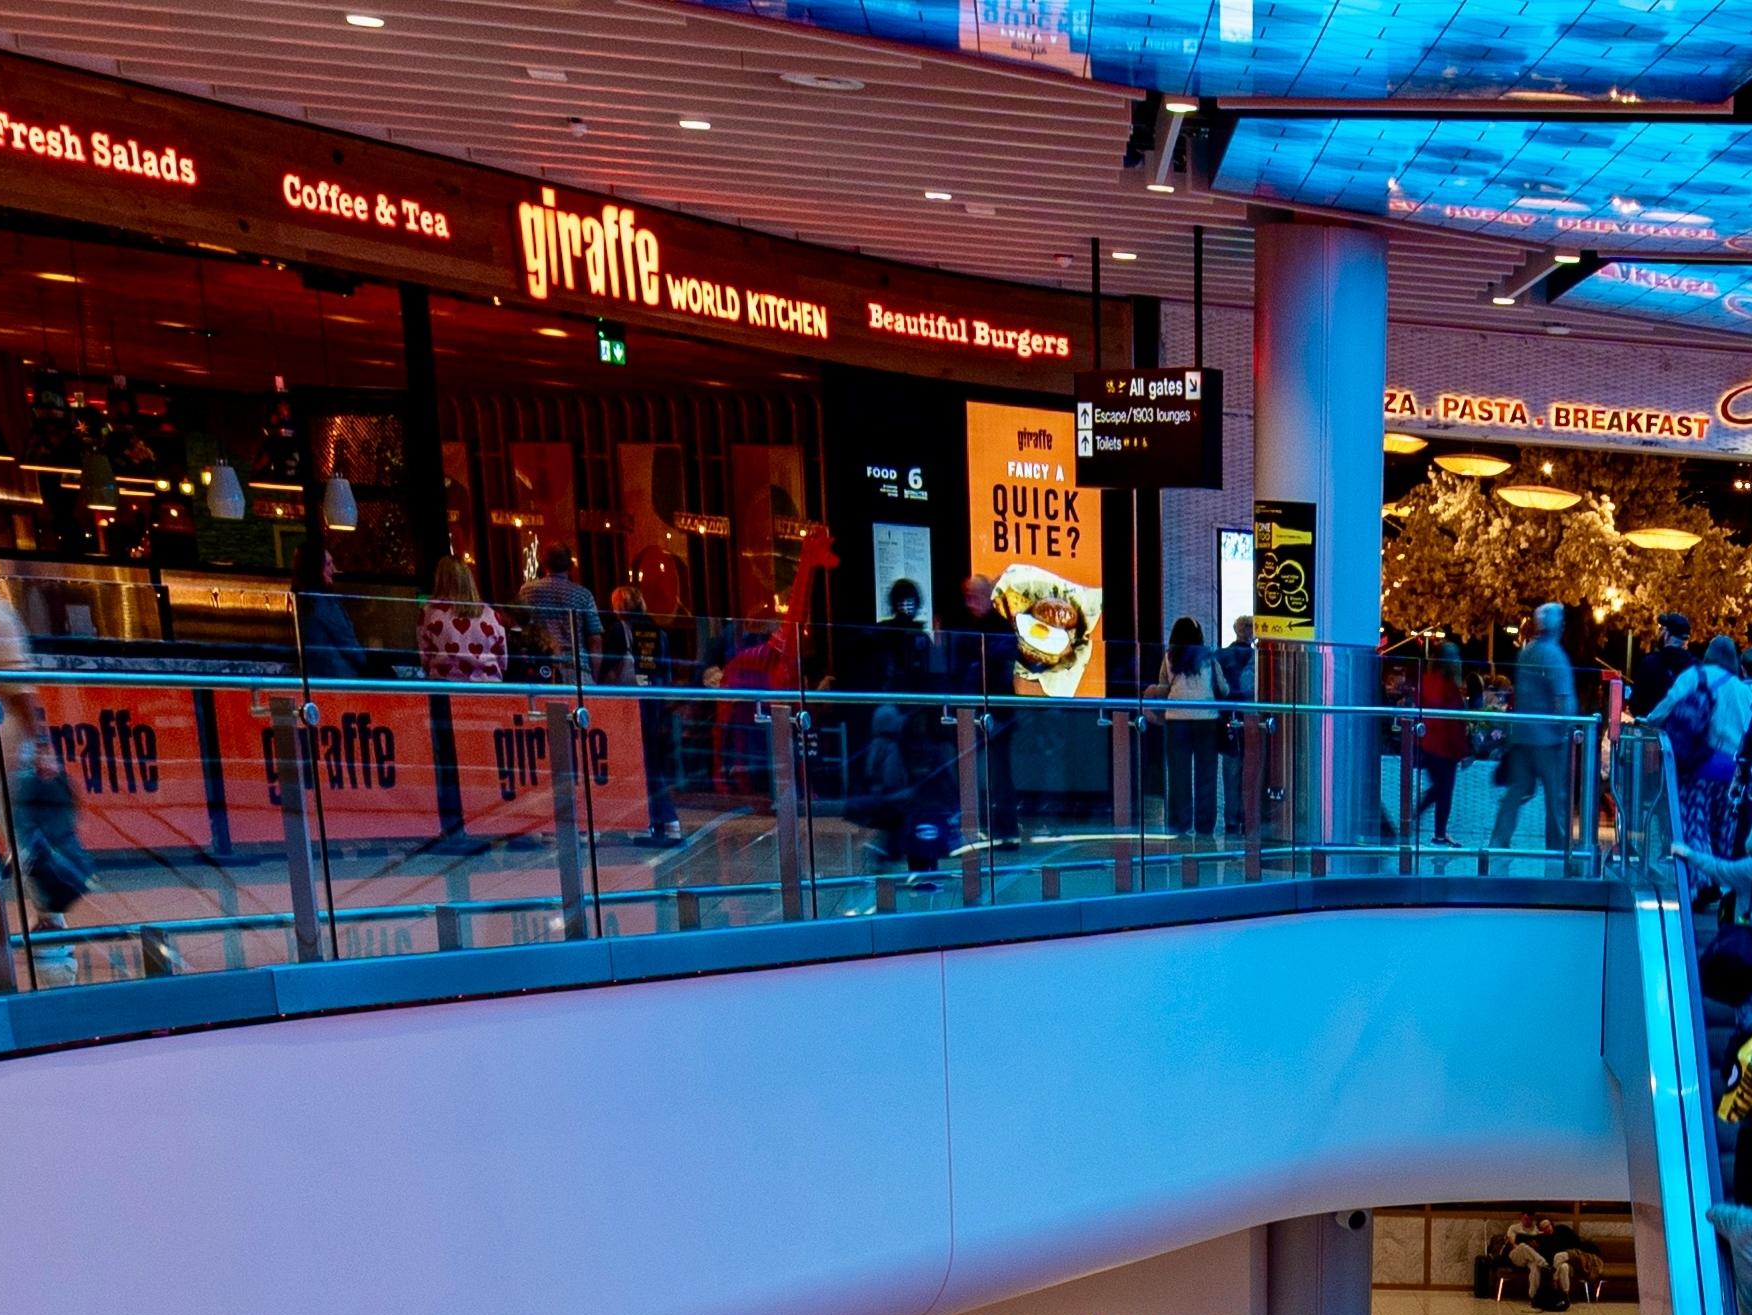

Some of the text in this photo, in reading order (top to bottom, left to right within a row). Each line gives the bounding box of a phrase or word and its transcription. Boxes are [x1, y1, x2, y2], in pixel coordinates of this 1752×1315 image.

[92, 133, 196, 184] Salads
[282, 175, 450, 239] Coffee & Tea
[519, 187, 828, 339] giraffe WORLD KITCHEN
[867, 303, 1069, 358] Beautiful Burgers
[1129, 375, 1183, 398] All gates
[1094, 408, 1191, 424] Escape/1903 lounges
[1443, 396, 1529, 427] PASTA
[1553, 408, 1710, 440] BREAKFAST
[1017, 427, 1054, 451] giraffe
[1095, 435, 1122, 451] Toilets
[866, 466, 897, 480] FOOD
[907, 467, 923, 489] 6
[1008, 461, 1065, 481] FANCY A
[992, 484, 1081, 523] QUICK
[993, 521, 1081, 558] BITE?
[261, 712, 396, 806] graffe
